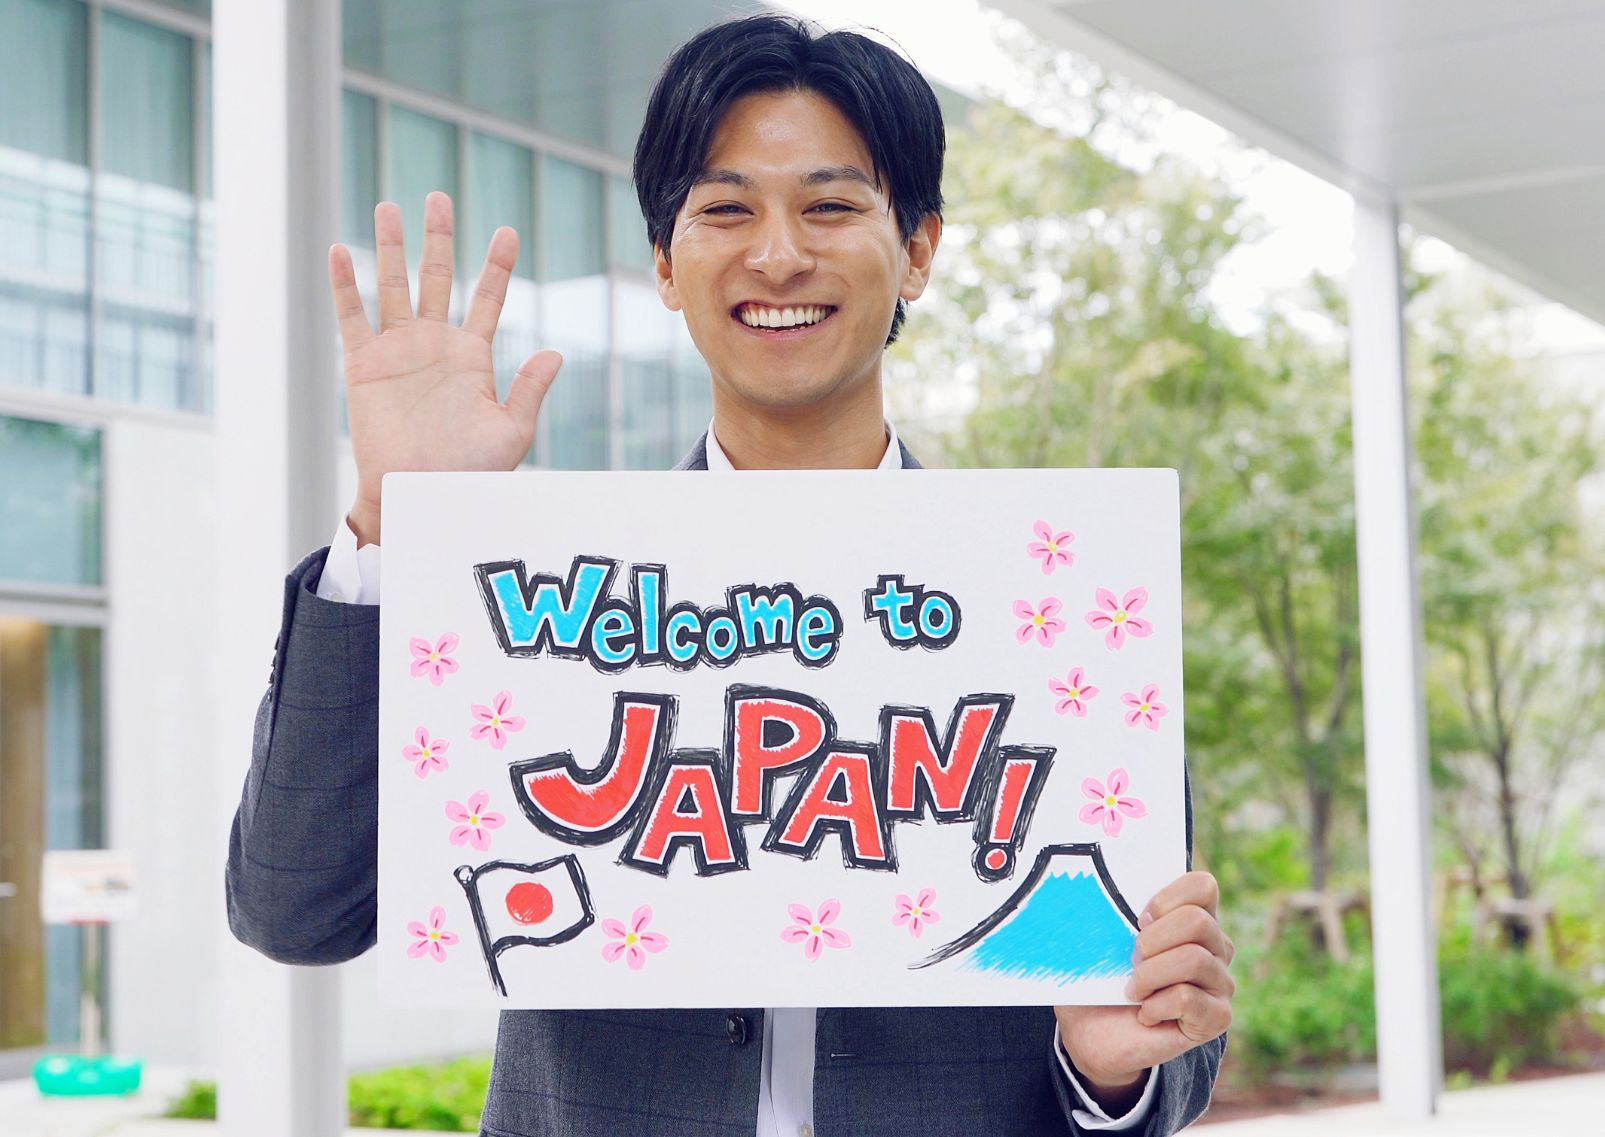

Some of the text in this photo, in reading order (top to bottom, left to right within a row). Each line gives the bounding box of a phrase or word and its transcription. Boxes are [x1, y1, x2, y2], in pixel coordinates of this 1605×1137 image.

[474, 555, 962, 674] Welcome to
[509, 684, 1056, 882] JAPAN!
